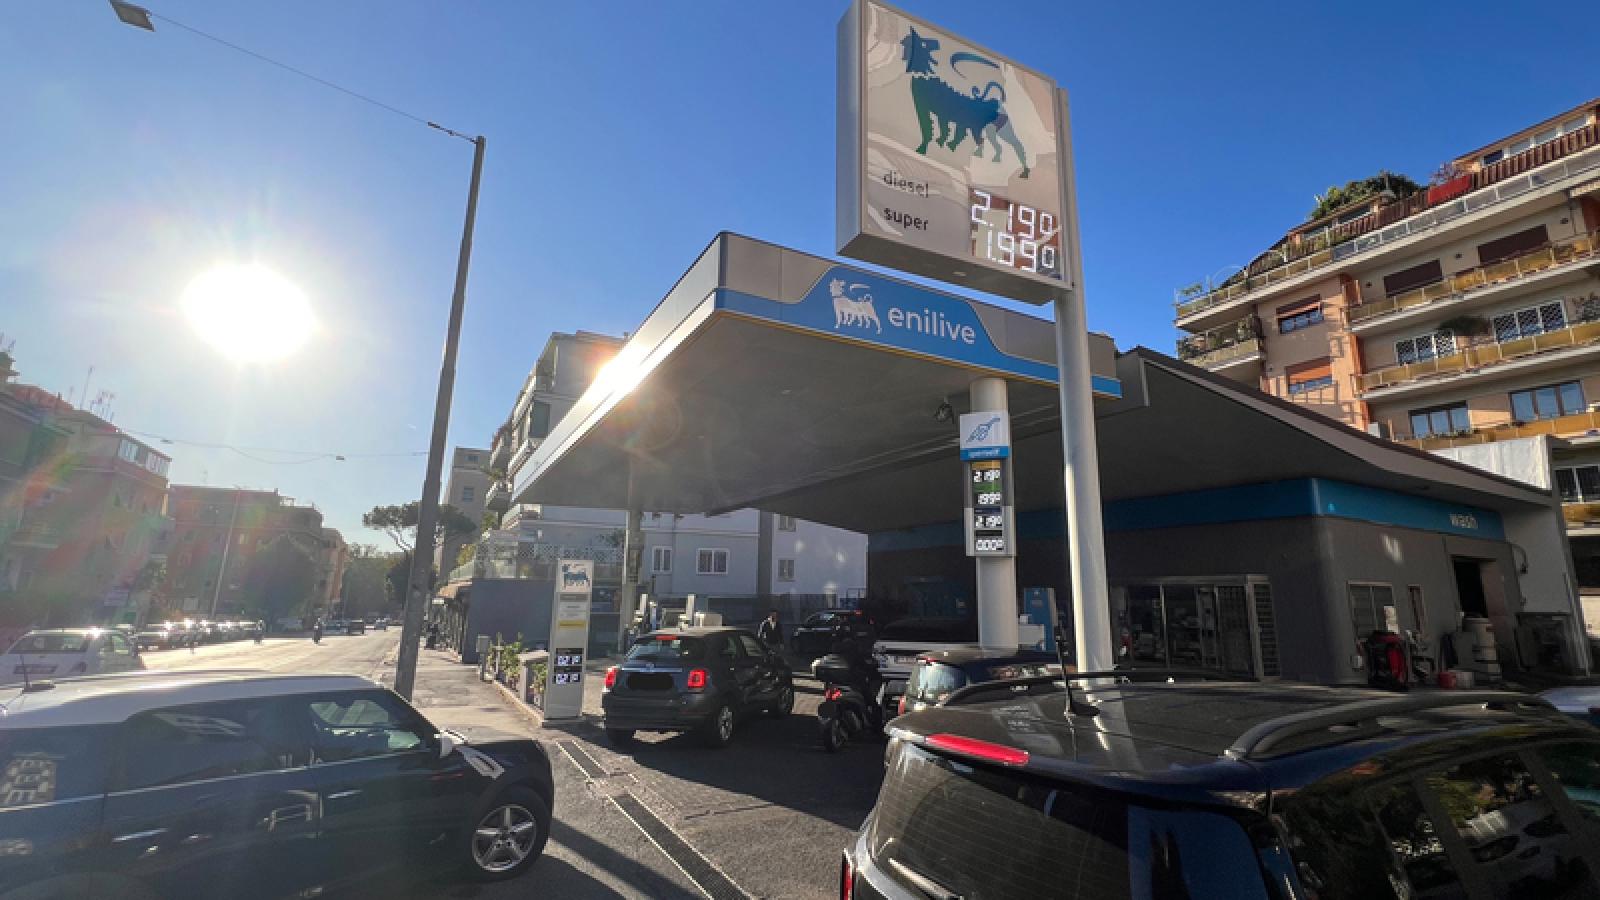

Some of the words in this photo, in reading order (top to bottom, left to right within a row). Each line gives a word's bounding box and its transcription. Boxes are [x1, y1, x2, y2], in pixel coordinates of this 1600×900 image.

[883, 170, 929, 198] diesel
[883, 207, 929, 231] super
[888, 307, 976, 345] enilive
